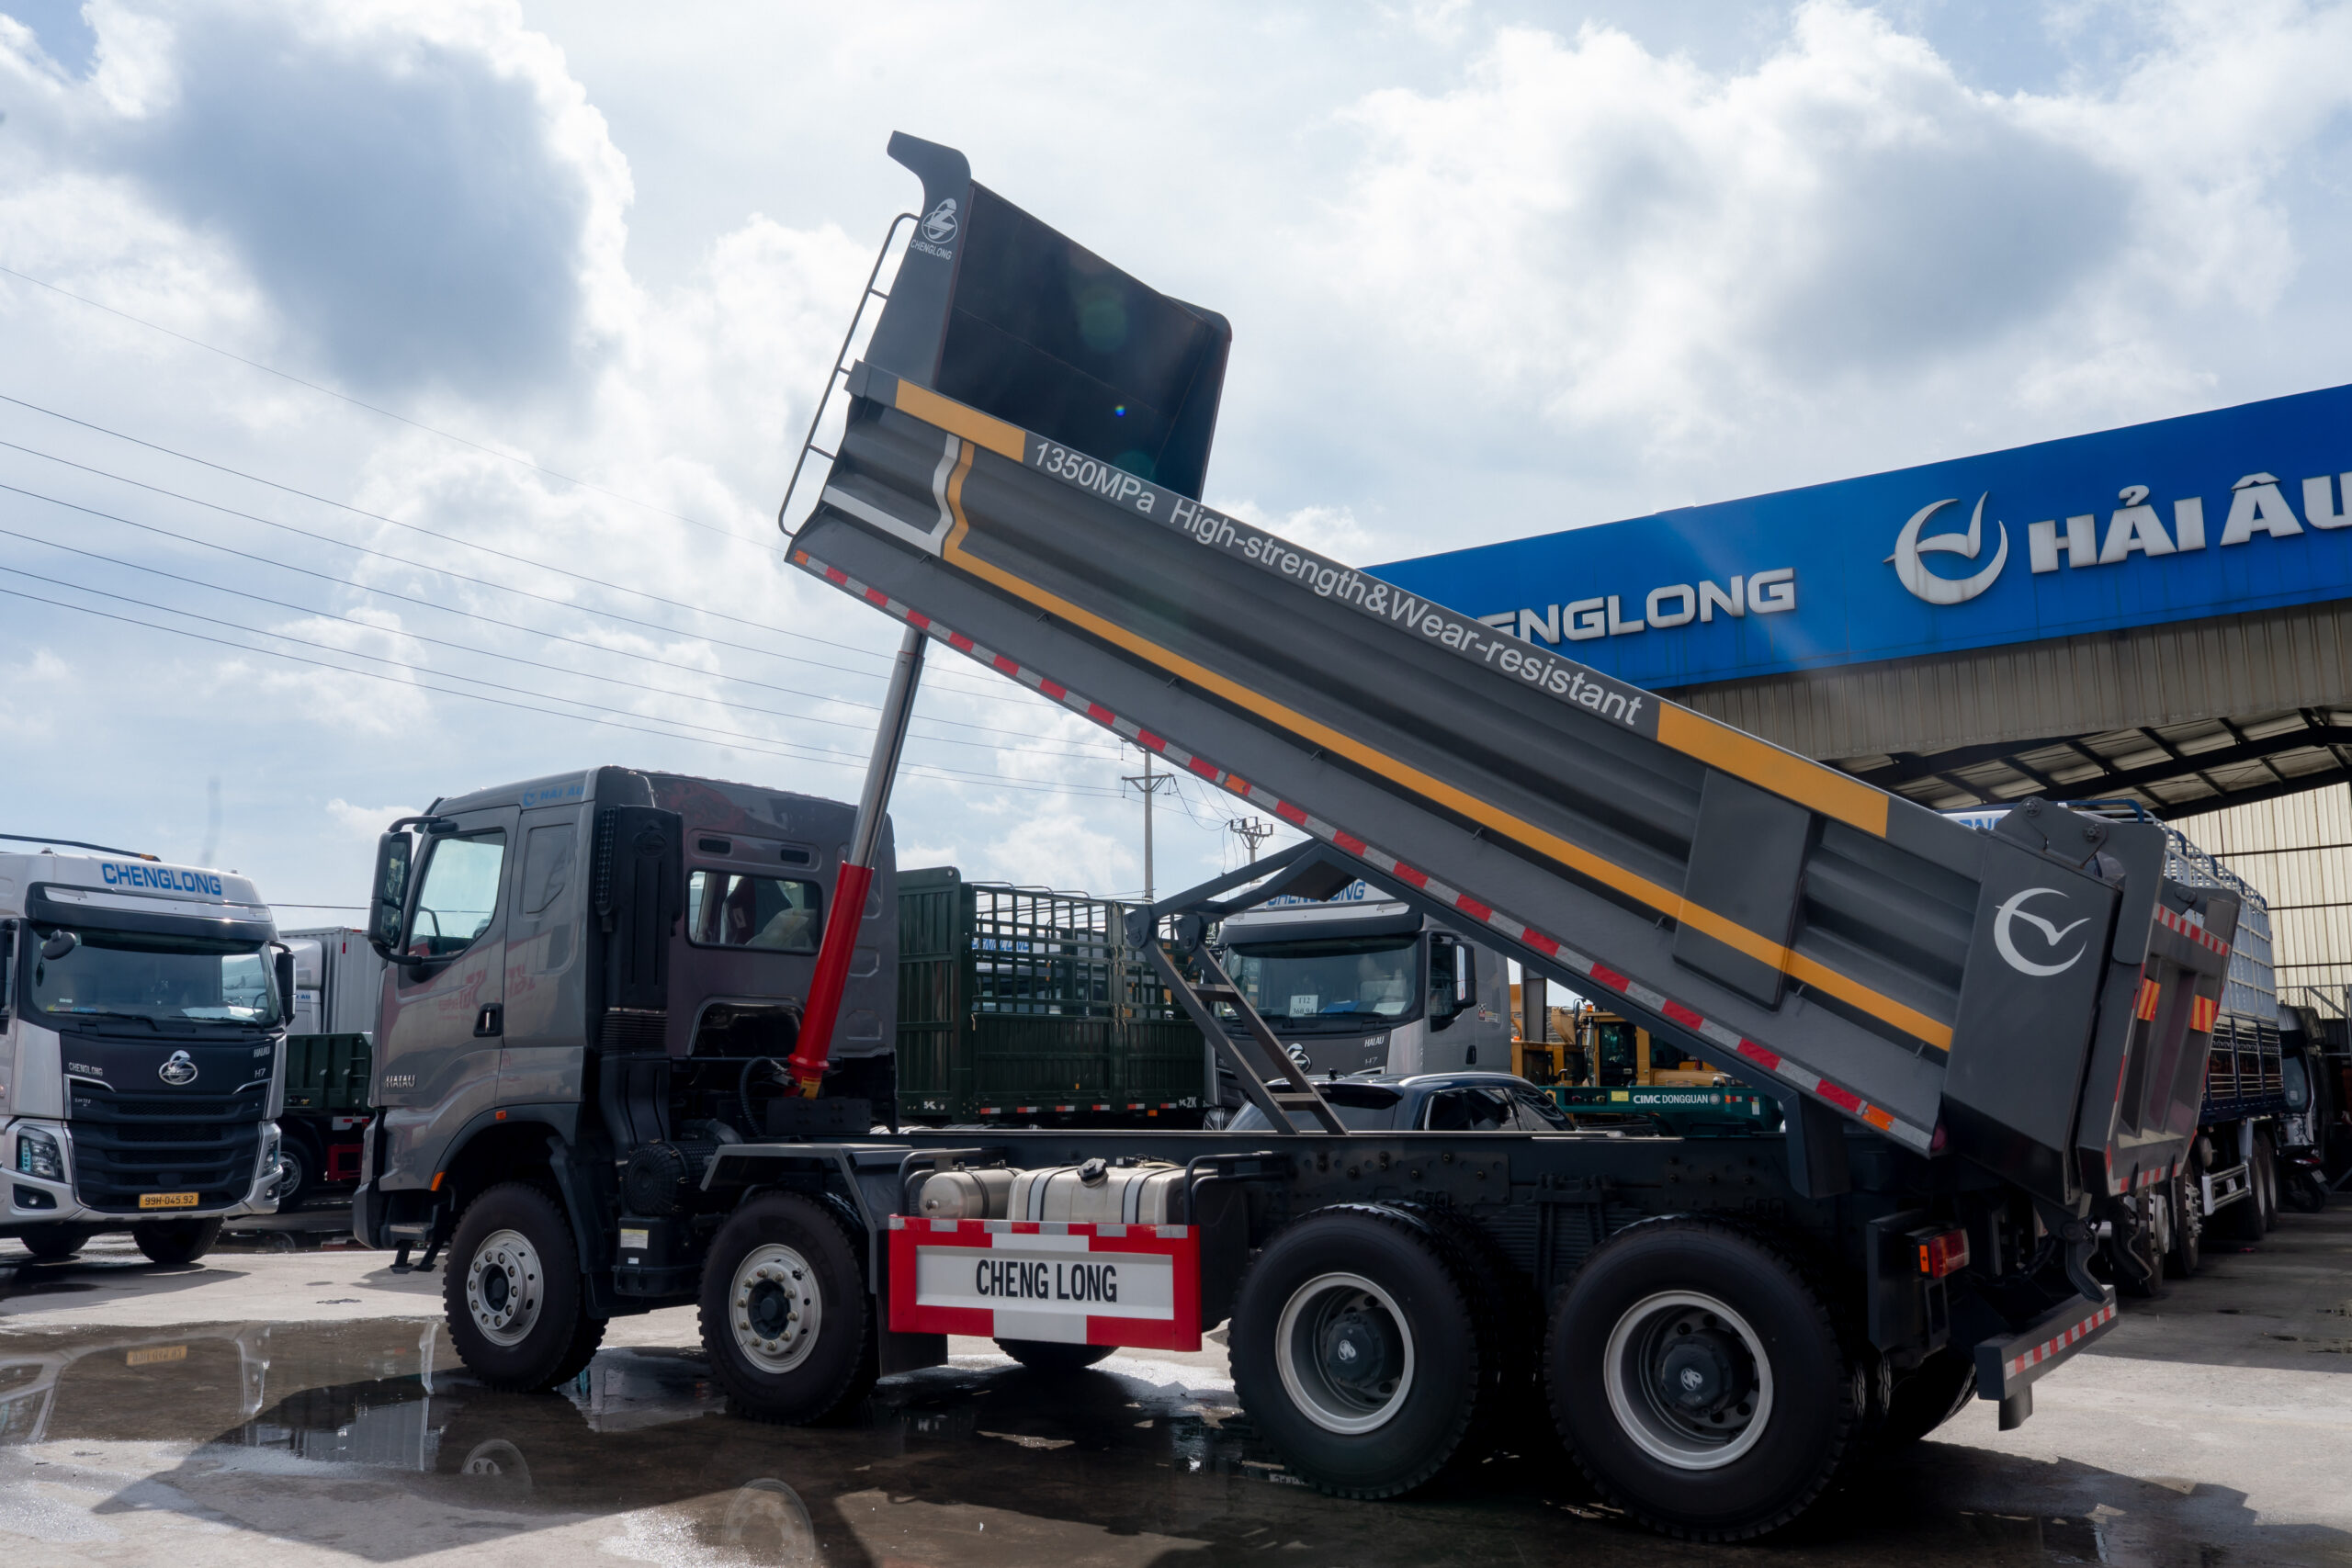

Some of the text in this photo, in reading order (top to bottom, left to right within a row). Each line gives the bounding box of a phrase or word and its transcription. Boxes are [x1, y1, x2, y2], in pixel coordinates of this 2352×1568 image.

[910, 239, 953, 260] CHENGLONG
[1035, 442, 1156, 514] 1350MPa
[2028, 471, 2352, 574] HẢI ÂU
[101, 863, 222, 896] CHENGLONG
[69, 1062, 103, 1076] CHENGLONG
[1364, 1057, 1378, 1066] H7
[254, 1067, 266, 1078] H7
[1633, 1094, 1661, 1104] CIMC
[1662, 1094, 1709, 1104] DONGGUAN
[976, 1259, 1118, 1303] CHENG LONG
